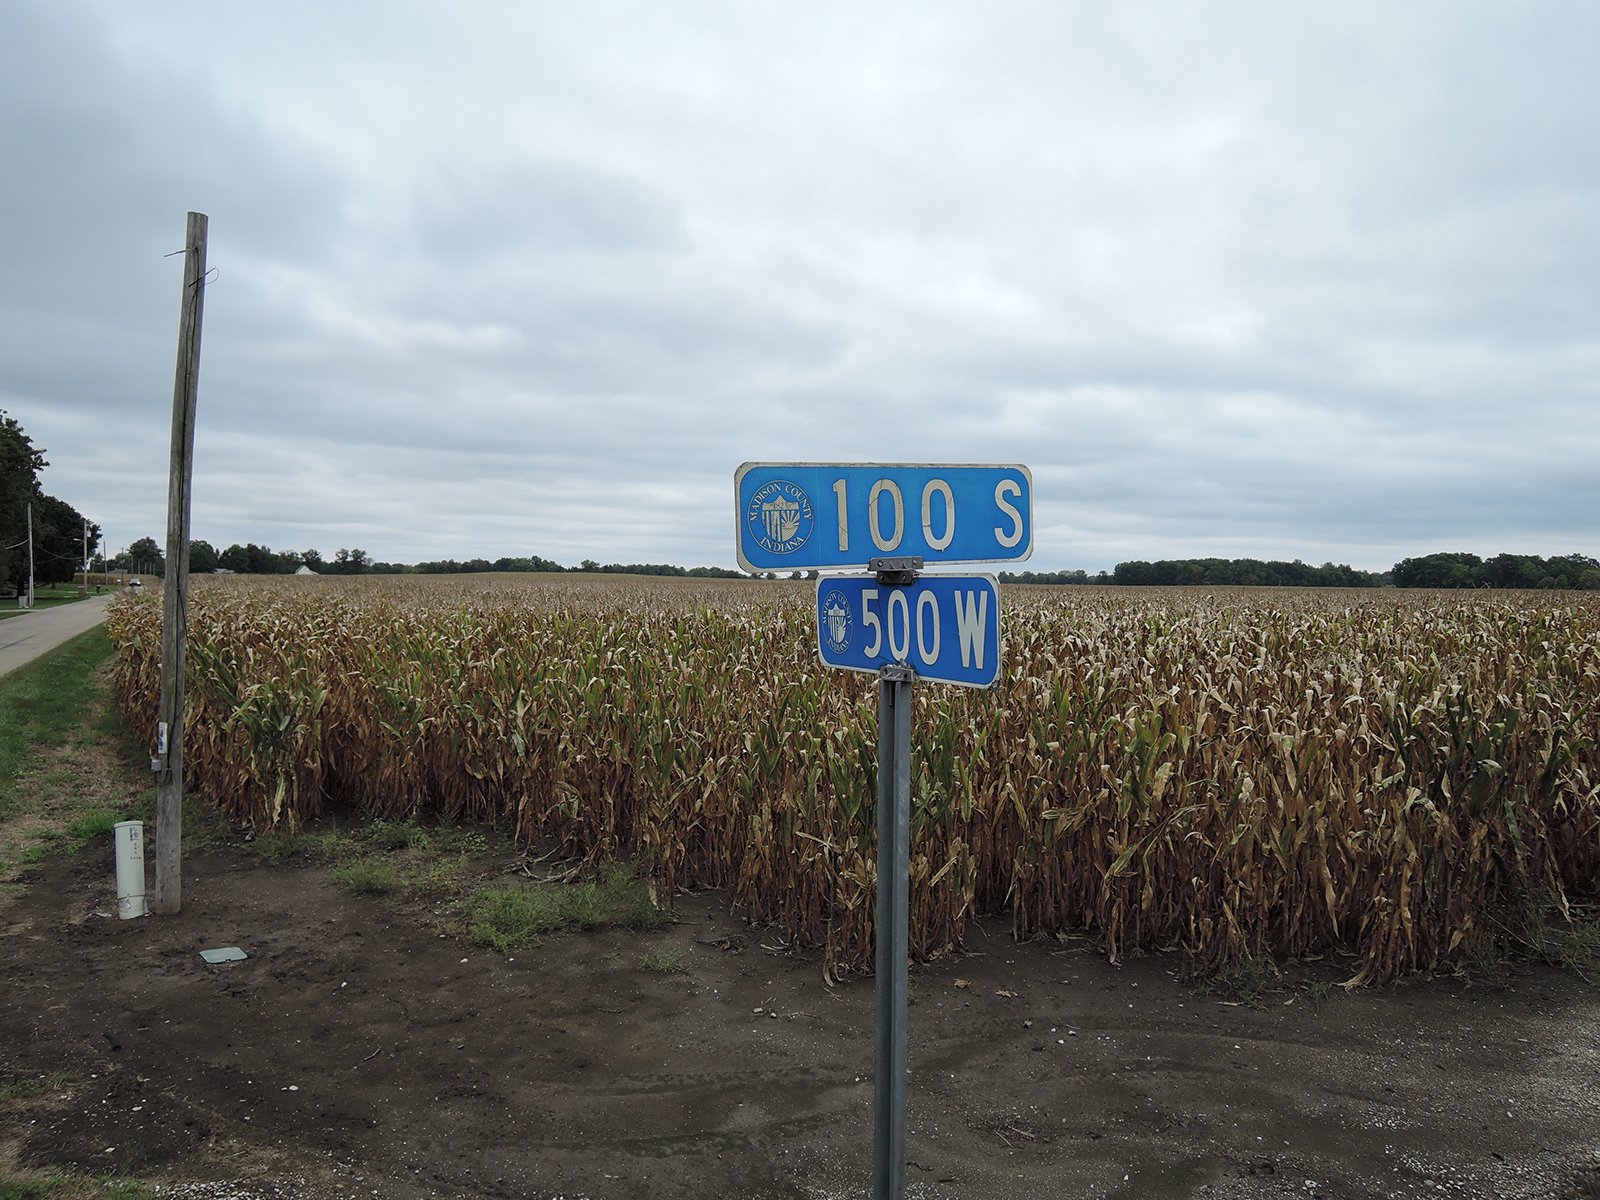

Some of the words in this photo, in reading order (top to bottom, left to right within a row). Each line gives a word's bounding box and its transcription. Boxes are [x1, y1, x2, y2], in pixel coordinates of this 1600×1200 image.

[749, 482, 781, 521] MADISON
[784, 484, 812, 520] COUNTY
[832, 478, 956, 552] 100
[993, 478, 1024, 548] S
[760, 536, 804, 552] INDIANA
[861, 588, 941, 666] 500
[954, 590, 988, 670] W
